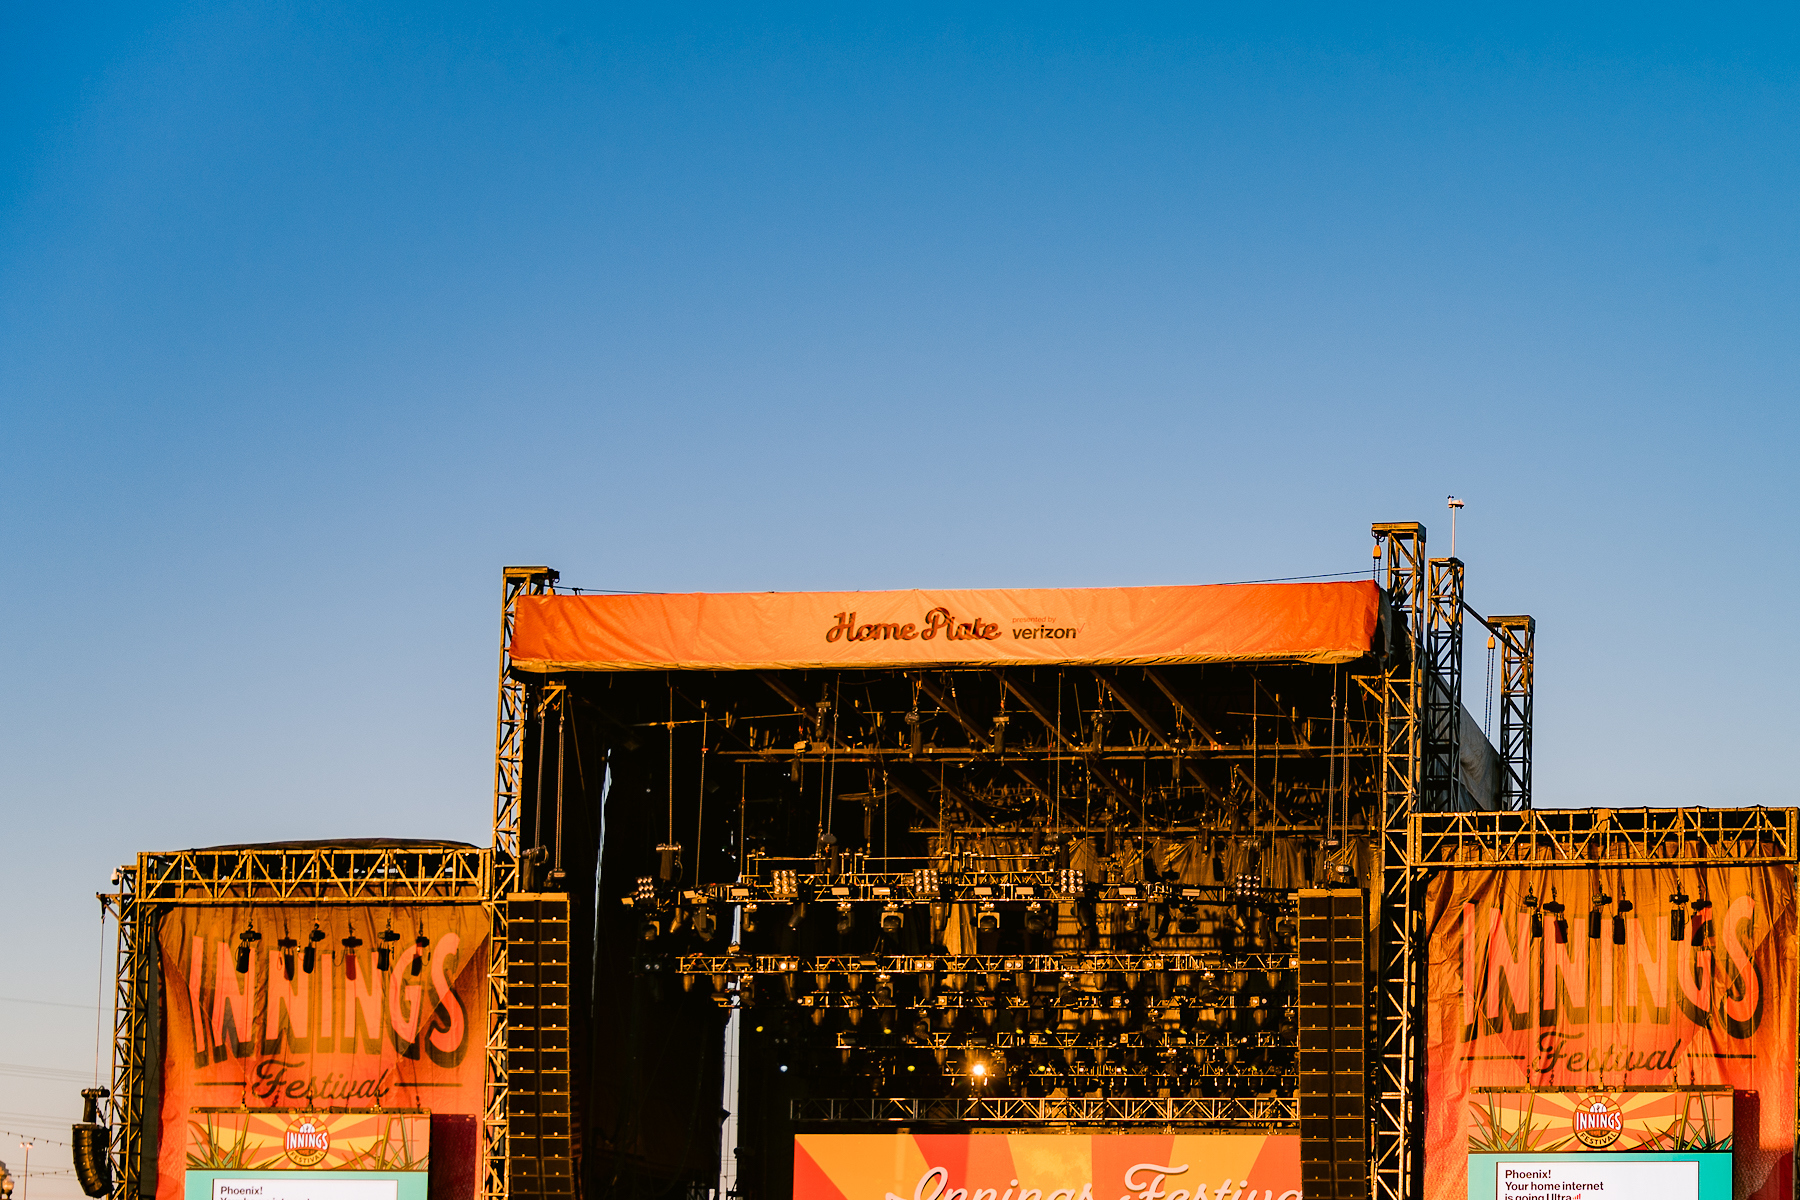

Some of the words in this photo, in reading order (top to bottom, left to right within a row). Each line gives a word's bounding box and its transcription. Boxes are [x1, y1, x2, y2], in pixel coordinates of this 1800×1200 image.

[826, 611, 919, 643] Home
[920, 606, 1002, 642] Plate
[1012, 616, 1045, 624] presented
[1046, 616, 1057, 624] by
[1012, 625, 1077, 640] verizon
[1461, 895, 1762, 1044] INNINGS
[189, 932, 468, 1068] INNINGS
[1532, 1031, 1681, 1074] Festival
[252, 1059, 390, 1100] Festival
[1576, 1111, 1621, 1131] INNINGS
[287, 1131, 328, 1150] INNINGS
[1579, 1132, 1617, 1145] FESTIVAL
[290, 1151, 324, 1164] FESTIVAL
[1505, 1169, 1551, 1179] Phoenix!
[221, 1186, 263, 1195] Phoenix!
[1505, 1181, 1529, 1191] Your
[1530, 1181, 1560, 1191] home
[1562, 1181, 1604, 1191] internet
